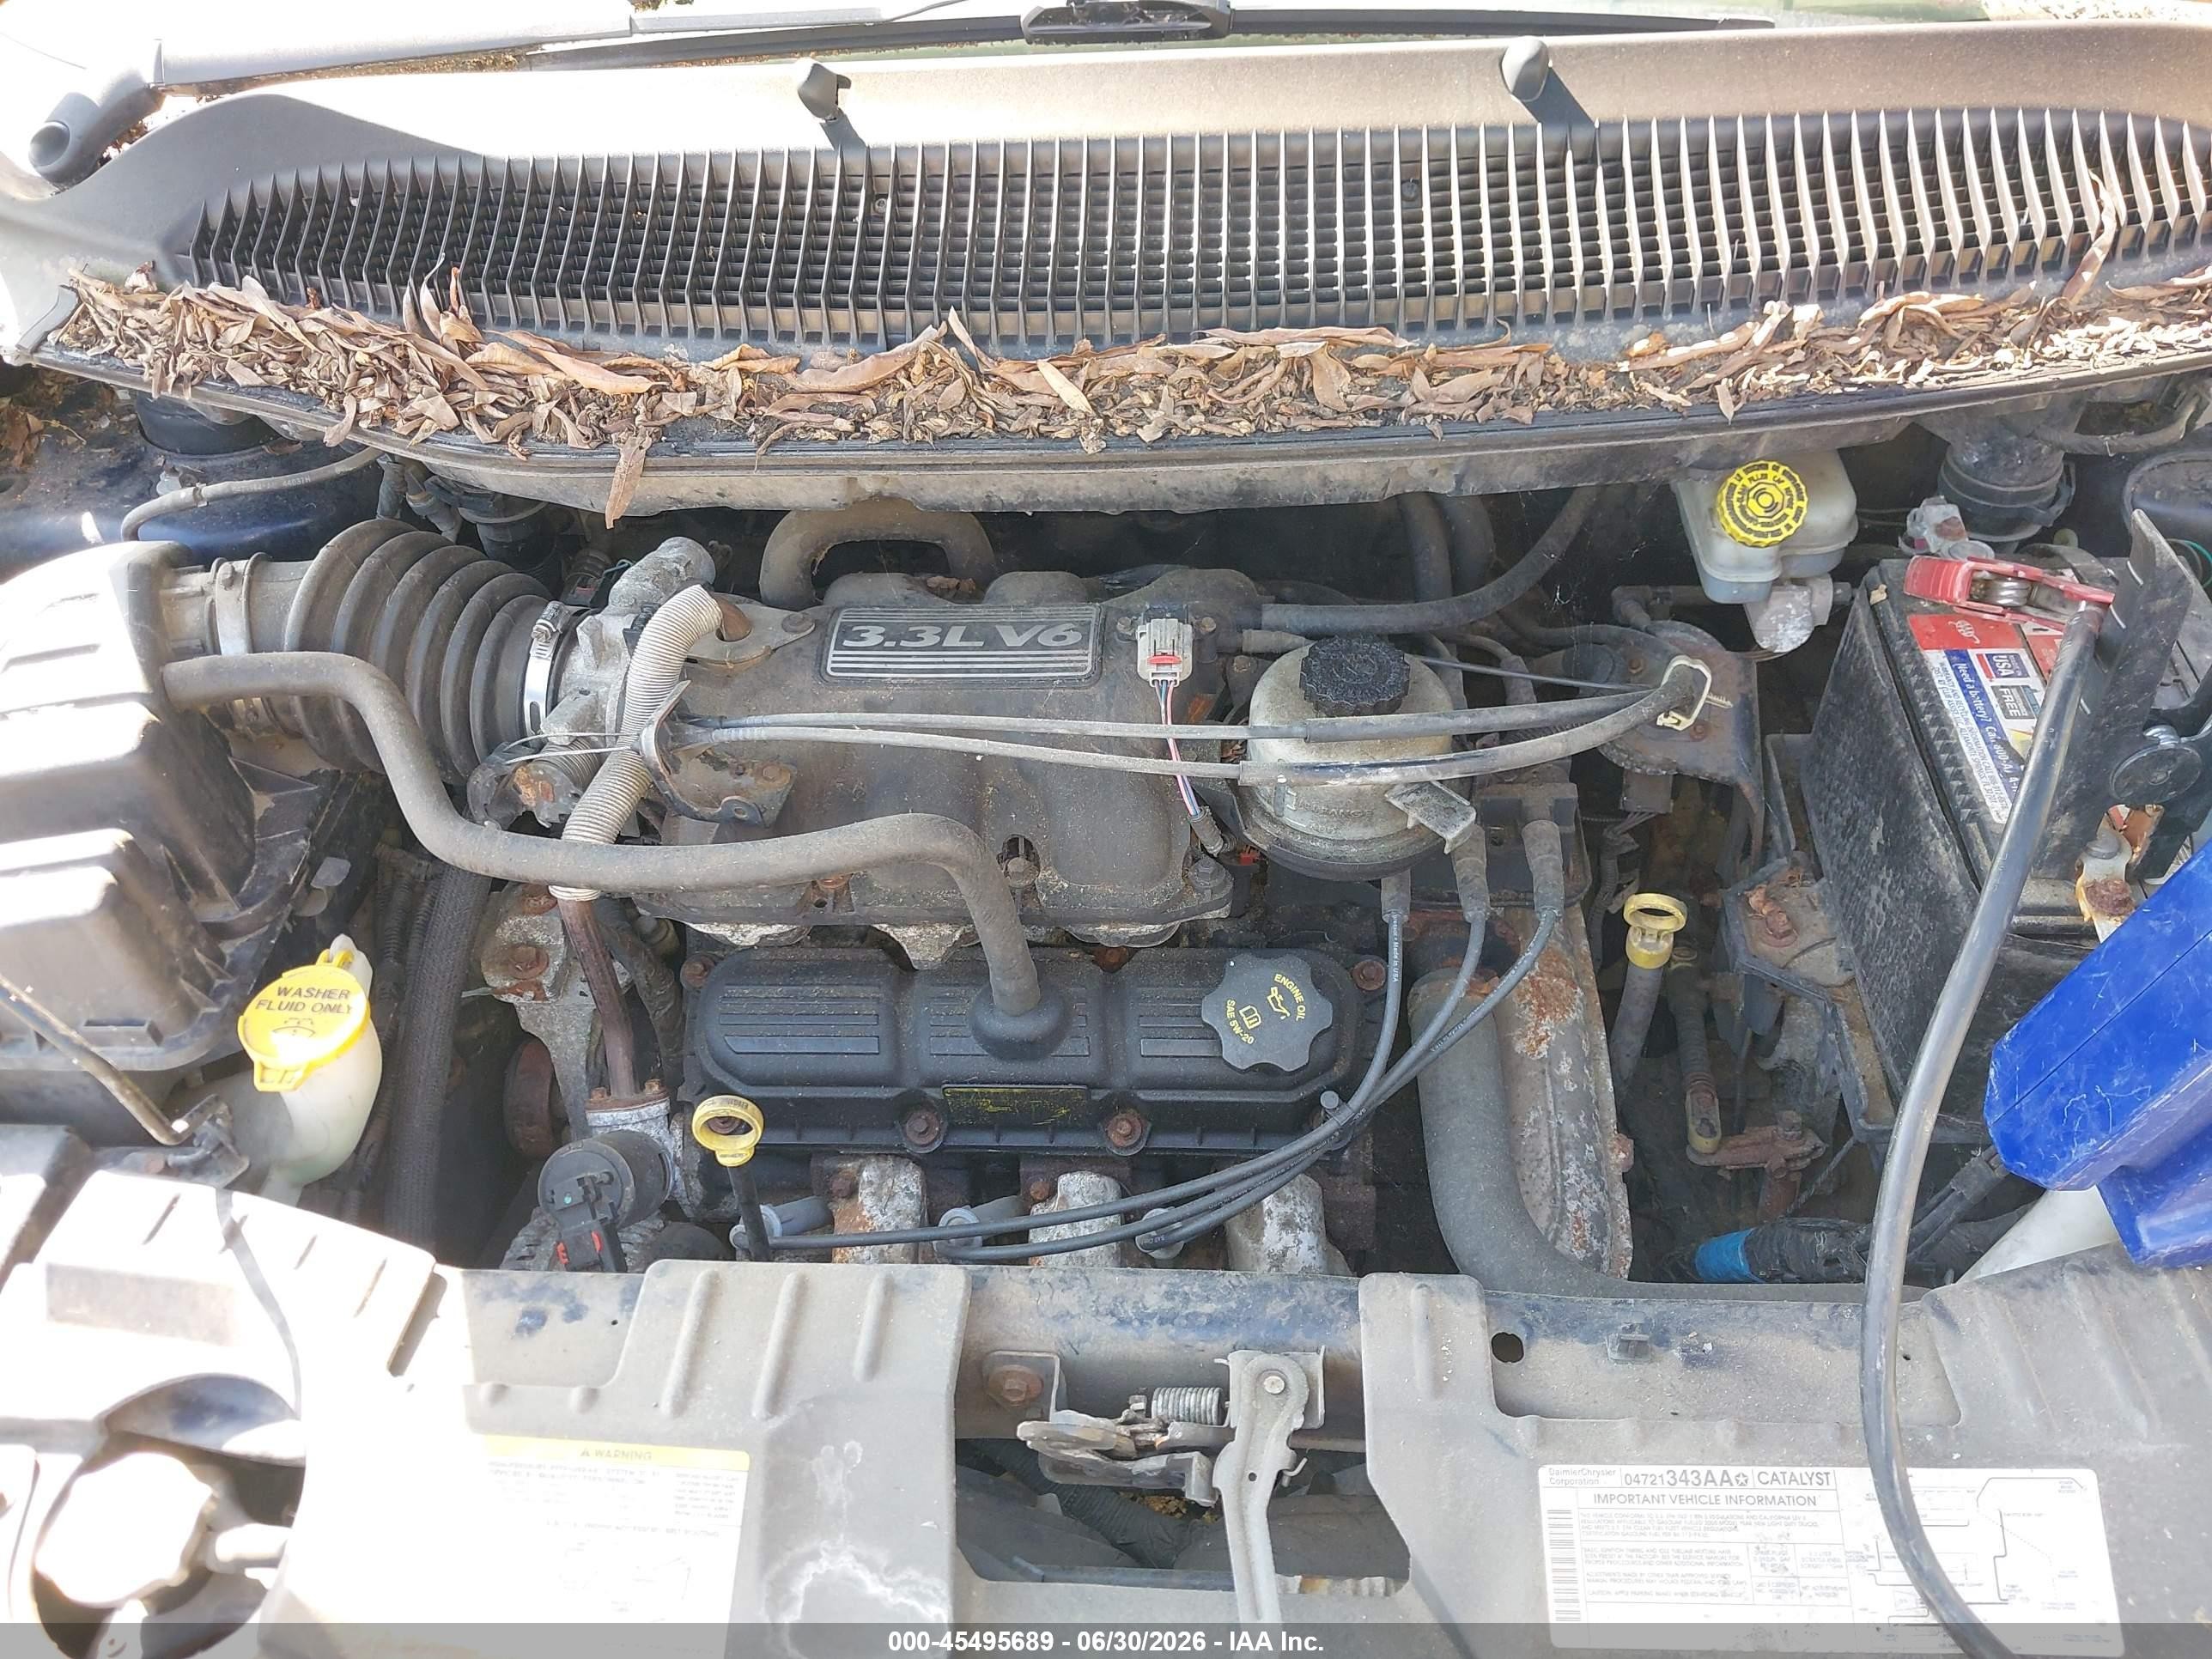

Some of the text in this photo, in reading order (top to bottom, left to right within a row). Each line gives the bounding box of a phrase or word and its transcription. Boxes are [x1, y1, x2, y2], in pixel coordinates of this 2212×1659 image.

[842, 623, 1083, 647] 3.3L V6
[1991, 655, 2015, 675] USA
[1997, 688, 2021, 716] FREE
[276, 986, 350, 1000] WASHER
[1273, 973, 1306, 1022] ENGINE OIL
[255, 999, 353, 1014] FLUID ONLY
[1226, 999, 1255, 1045] SAE 5W-20
[594, 1449, 653, 1462] WARNING
[1548, 1477, 1600, 1487] Corporation
[1757, 1471, 1831, 1486] CATALYST
[1594, 1493, 1817, 1507] IMPORTANT VEHICLE INFORMATION
